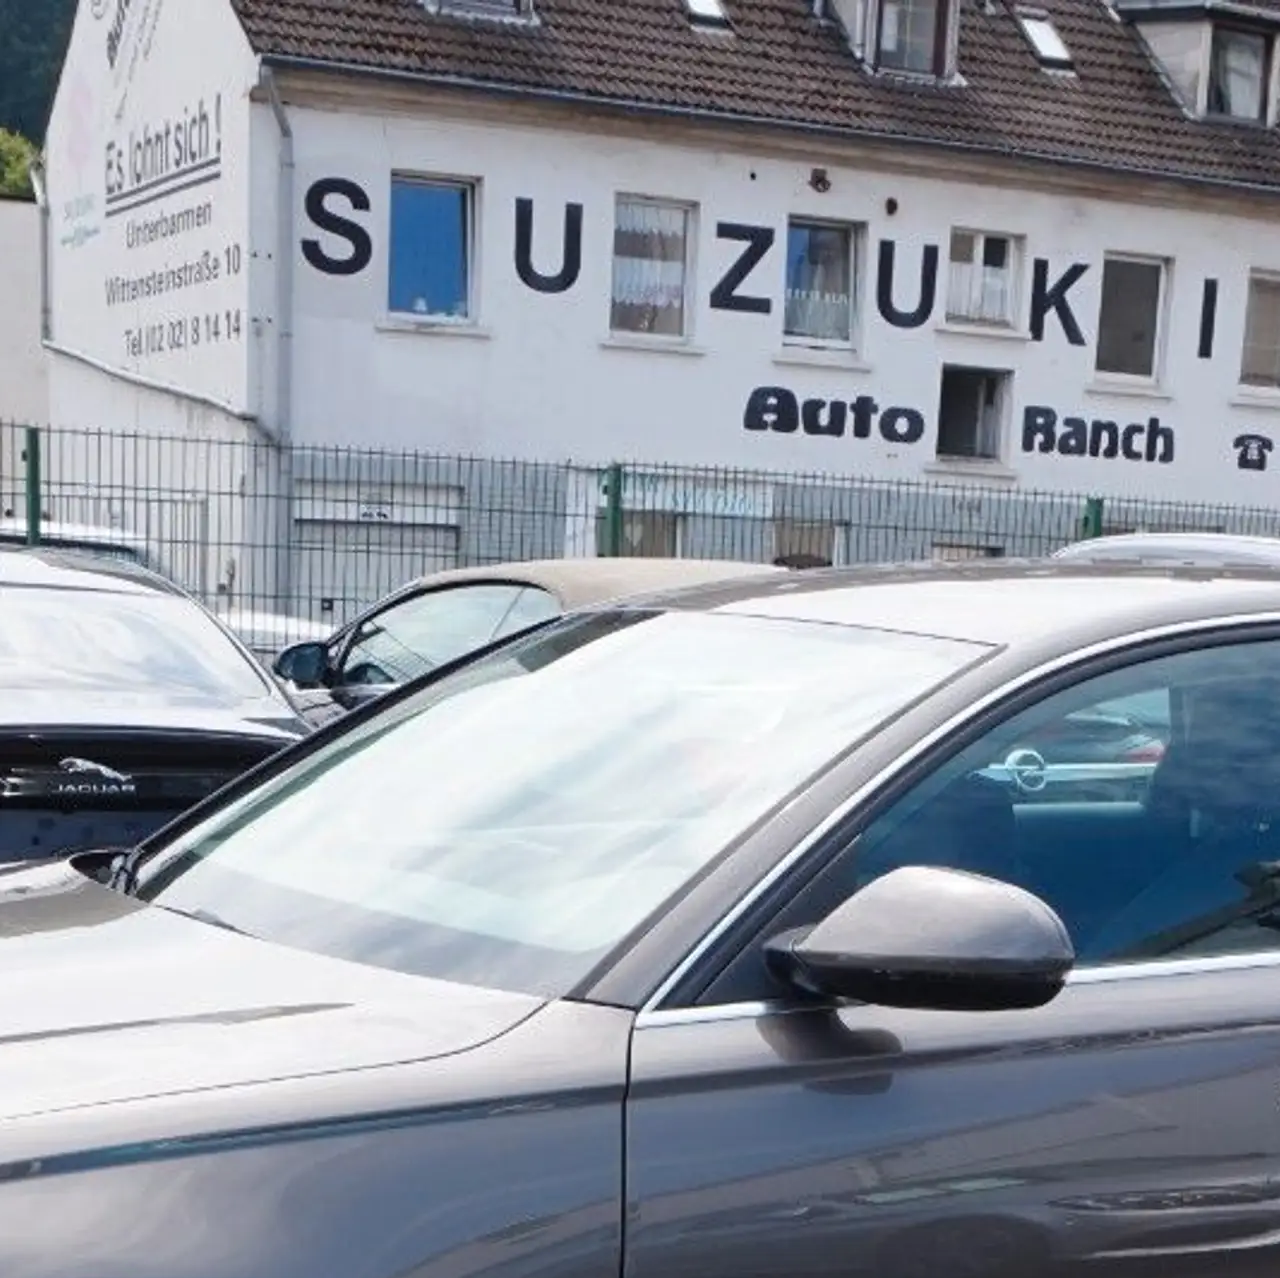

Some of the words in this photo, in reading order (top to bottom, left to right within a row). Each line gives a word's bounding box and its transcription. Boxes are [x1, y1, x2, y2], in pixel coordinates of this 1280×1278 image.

[106, 141, 124, 195] Es
[129, 119, 171, 186] lohnt
[174, 98, 209, 169] sich
[225, 243, 241, 275] 10
[205, 312, 220, 342] 14
[225, 308, 241, 341] 14
[743, 386, 925, 445] Auto
[1022, 405, 1175, 464] Ranch
[52, 783, 136, 794] JAGUAR
